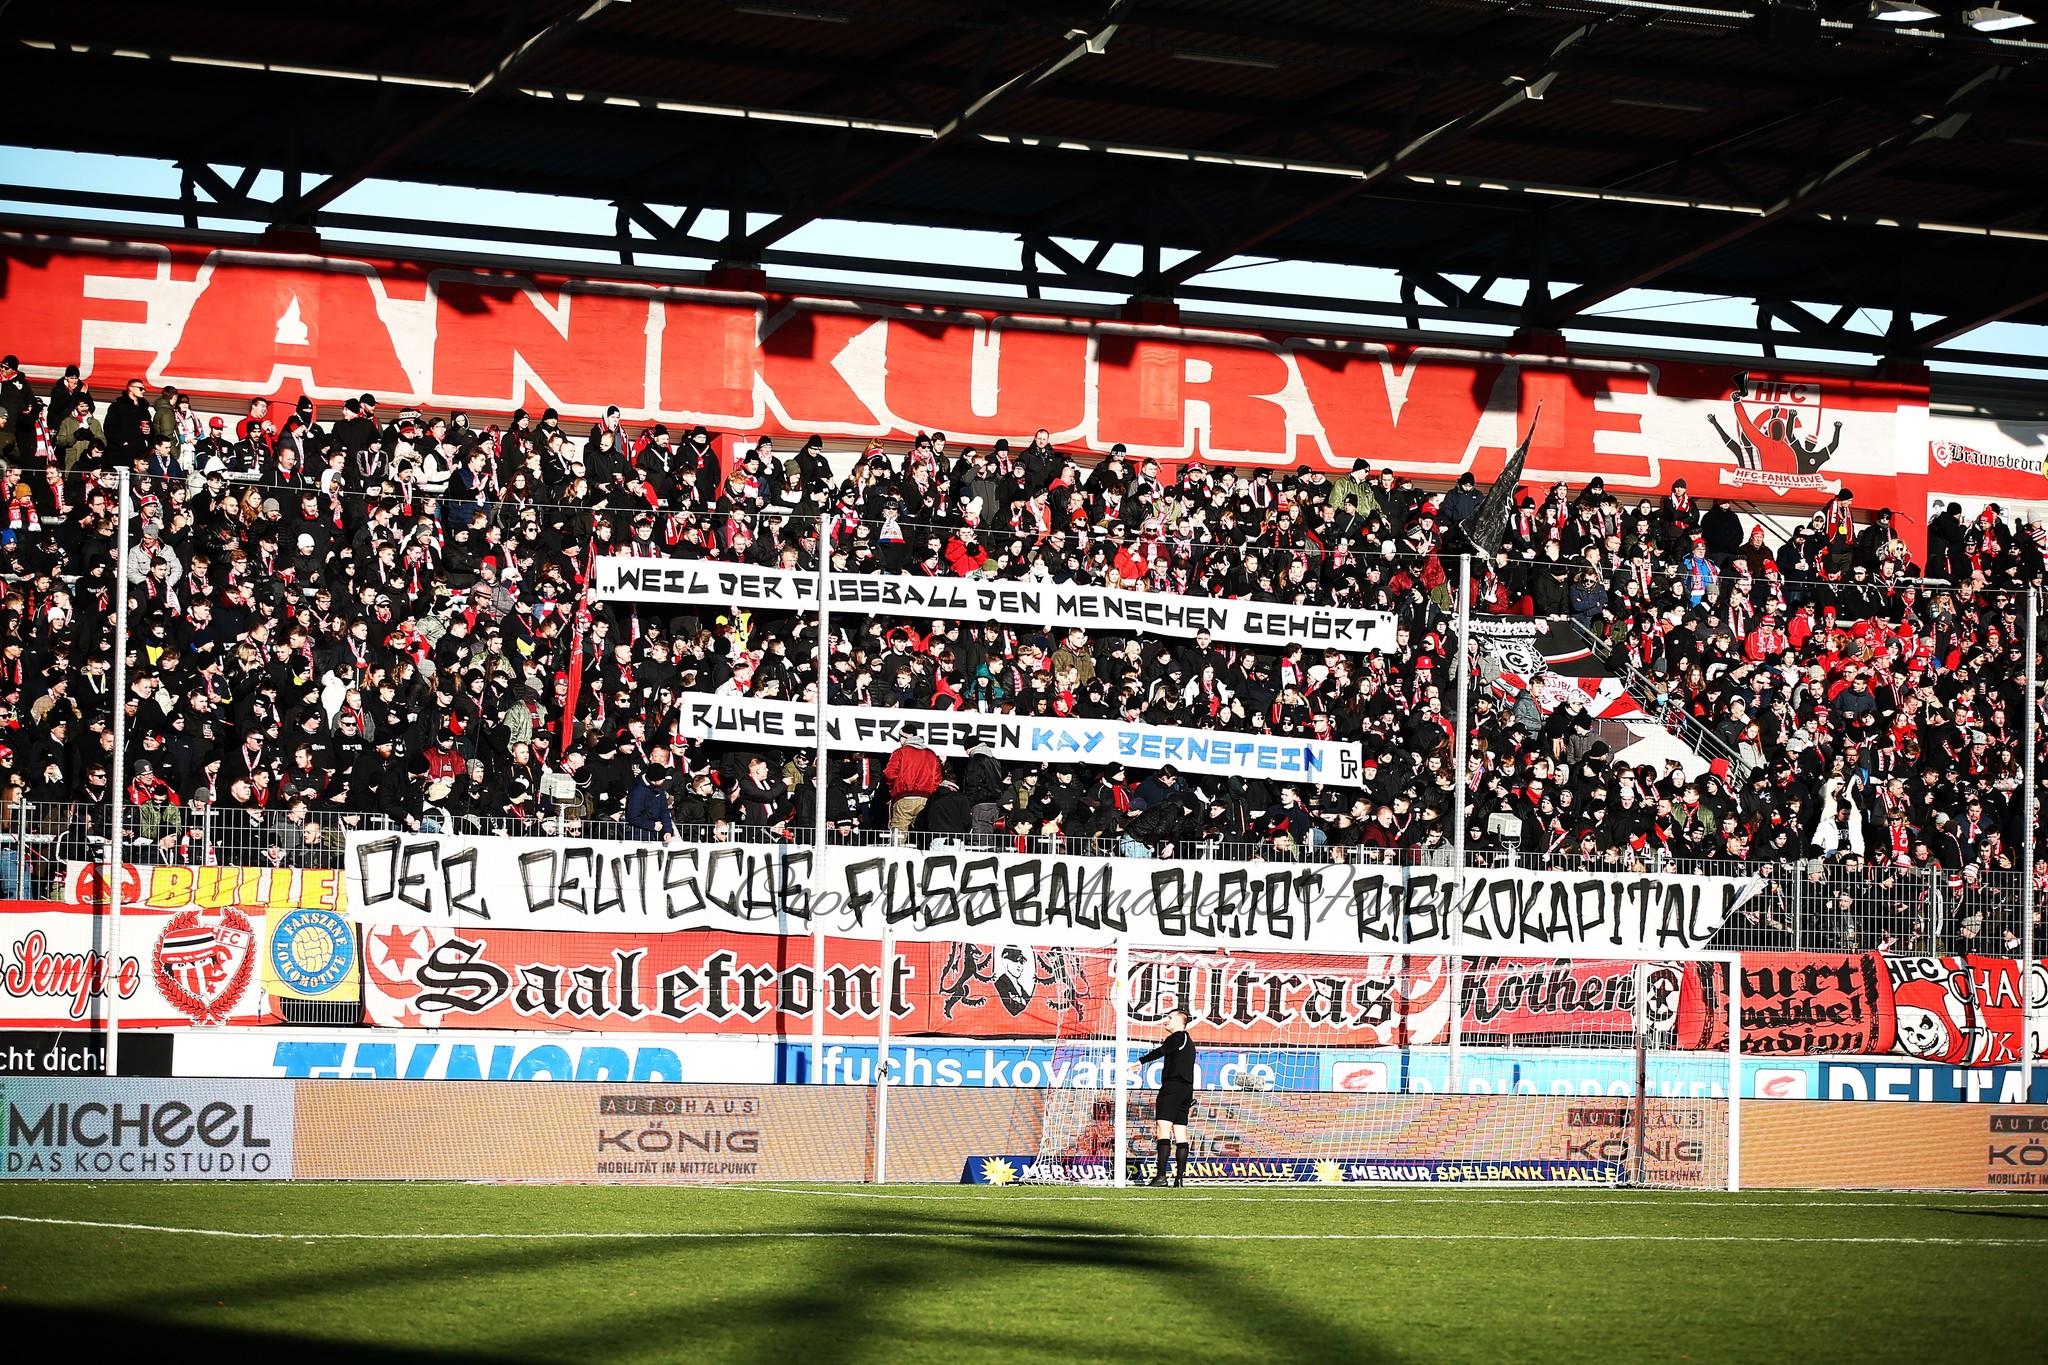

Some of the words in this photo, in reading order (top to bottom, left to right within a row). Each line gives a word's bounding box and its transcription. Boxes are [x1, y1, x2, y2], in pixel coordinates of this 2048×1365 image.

[0, 236, 1662, 488] FANKURVE
[1755, 382, 1808, 403] HFC
[1735, 469, 1823, 484] HFC-FANKURVE
[719, 573, 783, 599] DER
[792, 577, 967, 607] FUSSBALL
[976, 588, 1040, 612] DEN
[1056, 594, 1228, 631] MENSCHEN
[692, 703, 784, 734] RUHE
[795, 713, 841, 741] IN
[1031, 726, 1105, 753] KAY
[1118, 731, 1323, 773] BERNSTEIN
[356, 834, 491, 921] DER
[518, 846, 813, 921] DEUTSCHE
[844, 855, 1128, 932] FUSSBALL
[1151, 868, 1323, 942] BLEIBT
[211, 926, 242, 945] HFC
[283, 911, 348, 948] FANSZENE
[5, 929, 140, 1018] Sempe
[276, 942, 347, 988] LOKOMOTIVE
[414, 937, 915, 1018] Saalefront
[1885, 958, 1940, 987] HFC
[43, 1045, 106, 1072] dich!
[822, 1046, 1276, 1093] fuchs-kovatsc.de
[605, 1099, 755, 1114] AUTOHAUS
[1572, 1112, 1699, 1125] AUTOAUS
[598, 1120, 760, 1153] KÖNIG
[1566, 1131, 1703, 1162] KÖNIG
[8, 1152, 63, 1173] DAS
[75, 1152, 272, 1173] KOCHSTUDIO
[597, 1159, 658, 1174] MOBILITÄT
[661, 1162, 677, 1174] IM
[679, 1162, 758, 1174] MITTELPUNKT
[1233, 1161, 1295, 1178] HALLE
[1350, 1164, 1432, 1181] MERKUR
[1550, 1166, 1618, 1182] HALLE
[1648, 1169, 1702, 1181] TTELPUNKT
[1988, 1172, 2036, 1185] MOBILITÄT
